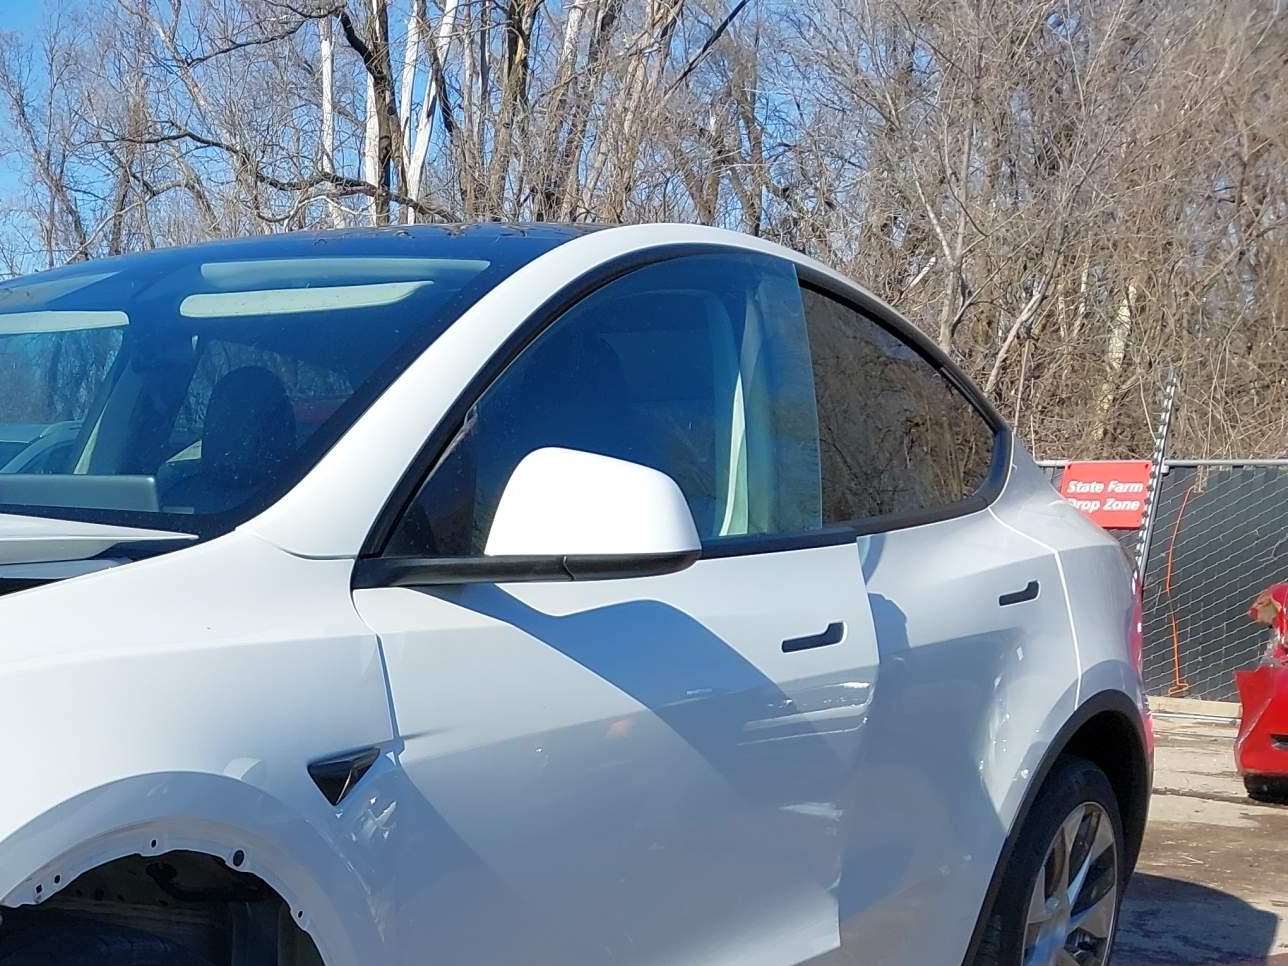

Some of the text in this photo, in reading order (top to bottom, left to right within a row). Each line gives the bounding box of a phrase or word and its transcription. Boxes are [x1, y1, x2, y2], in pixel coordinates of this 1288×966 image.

[1067, 480, 1144, 493] State Farm
[1103, 498, 1140, 511] Zone
